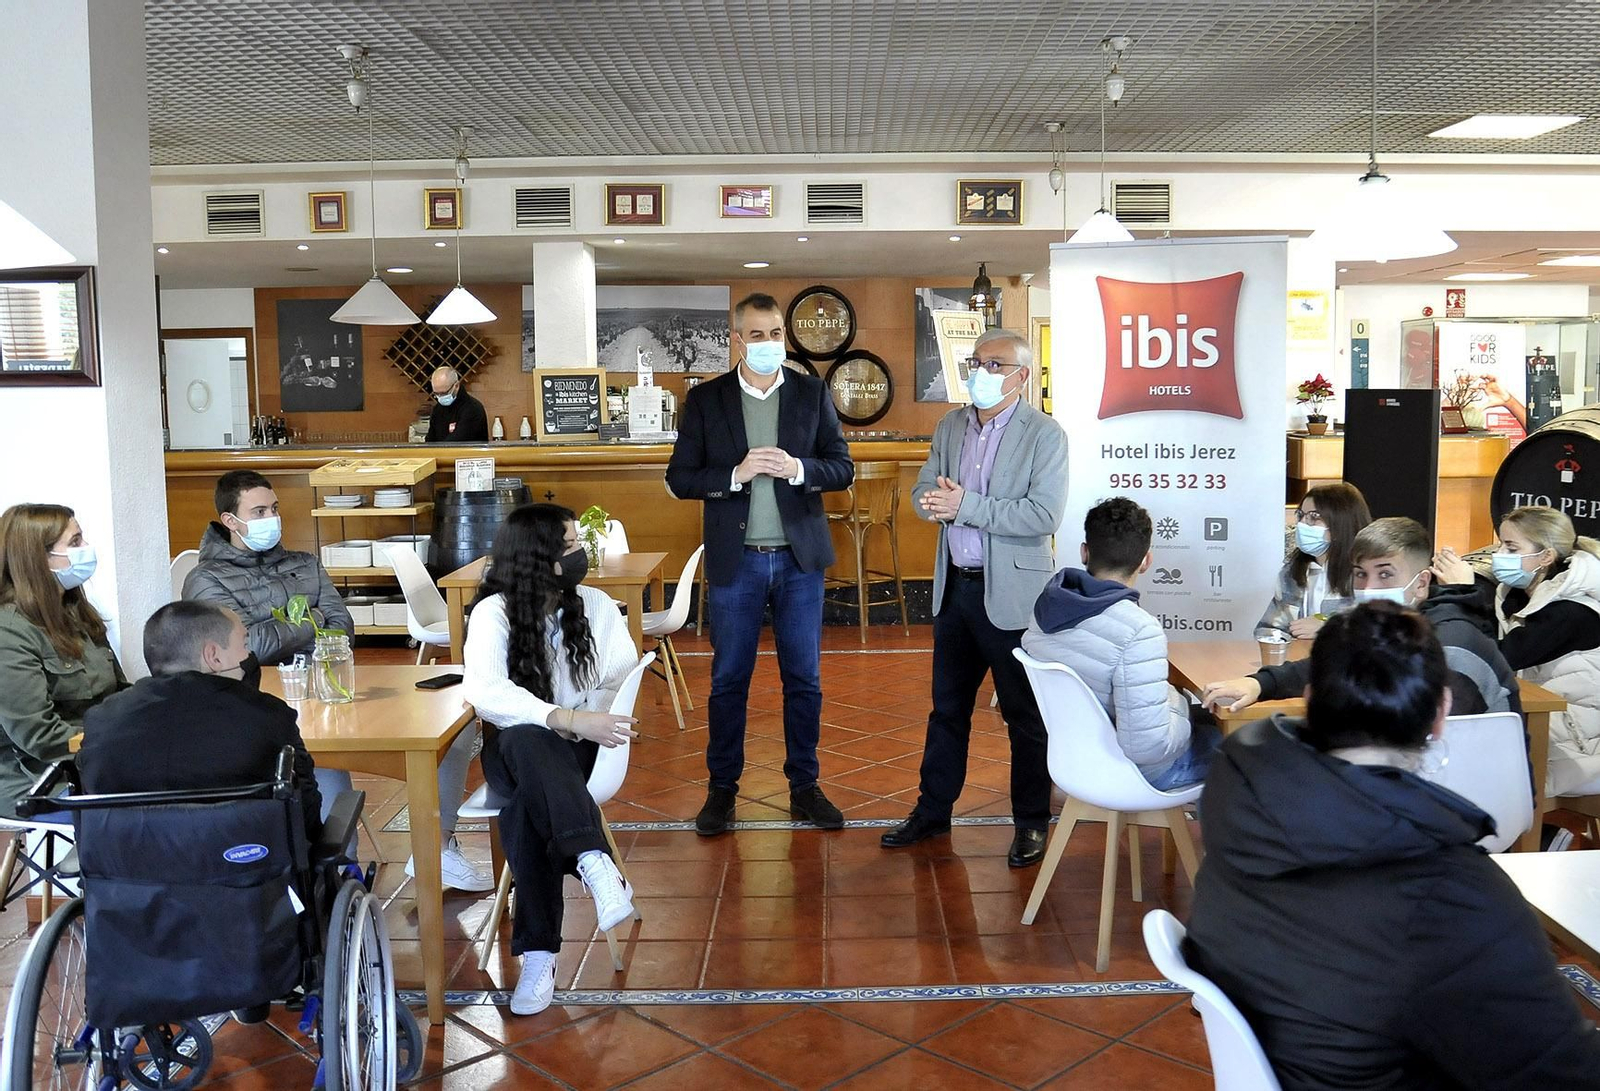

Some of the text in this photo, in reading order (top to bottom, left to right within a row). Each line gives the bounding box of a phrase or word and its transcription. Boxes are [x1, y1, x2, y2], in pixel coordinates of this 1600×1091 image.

[797, 319, 845, 328] TIO PEPE
[1120, 314, 1219, 369] ibis
[1470, 354, 1496, 363] KIDS
[833, 383, 885, 391] SOLERA 1847
[1149, 386, 1191, 395] HOTELS
[1101, 444, 1236, 460] Hotel ibis Jerez
[1110, 474, 1227, 490] 956 35 32 33
[1560, 497, 1600, 519] PEP
